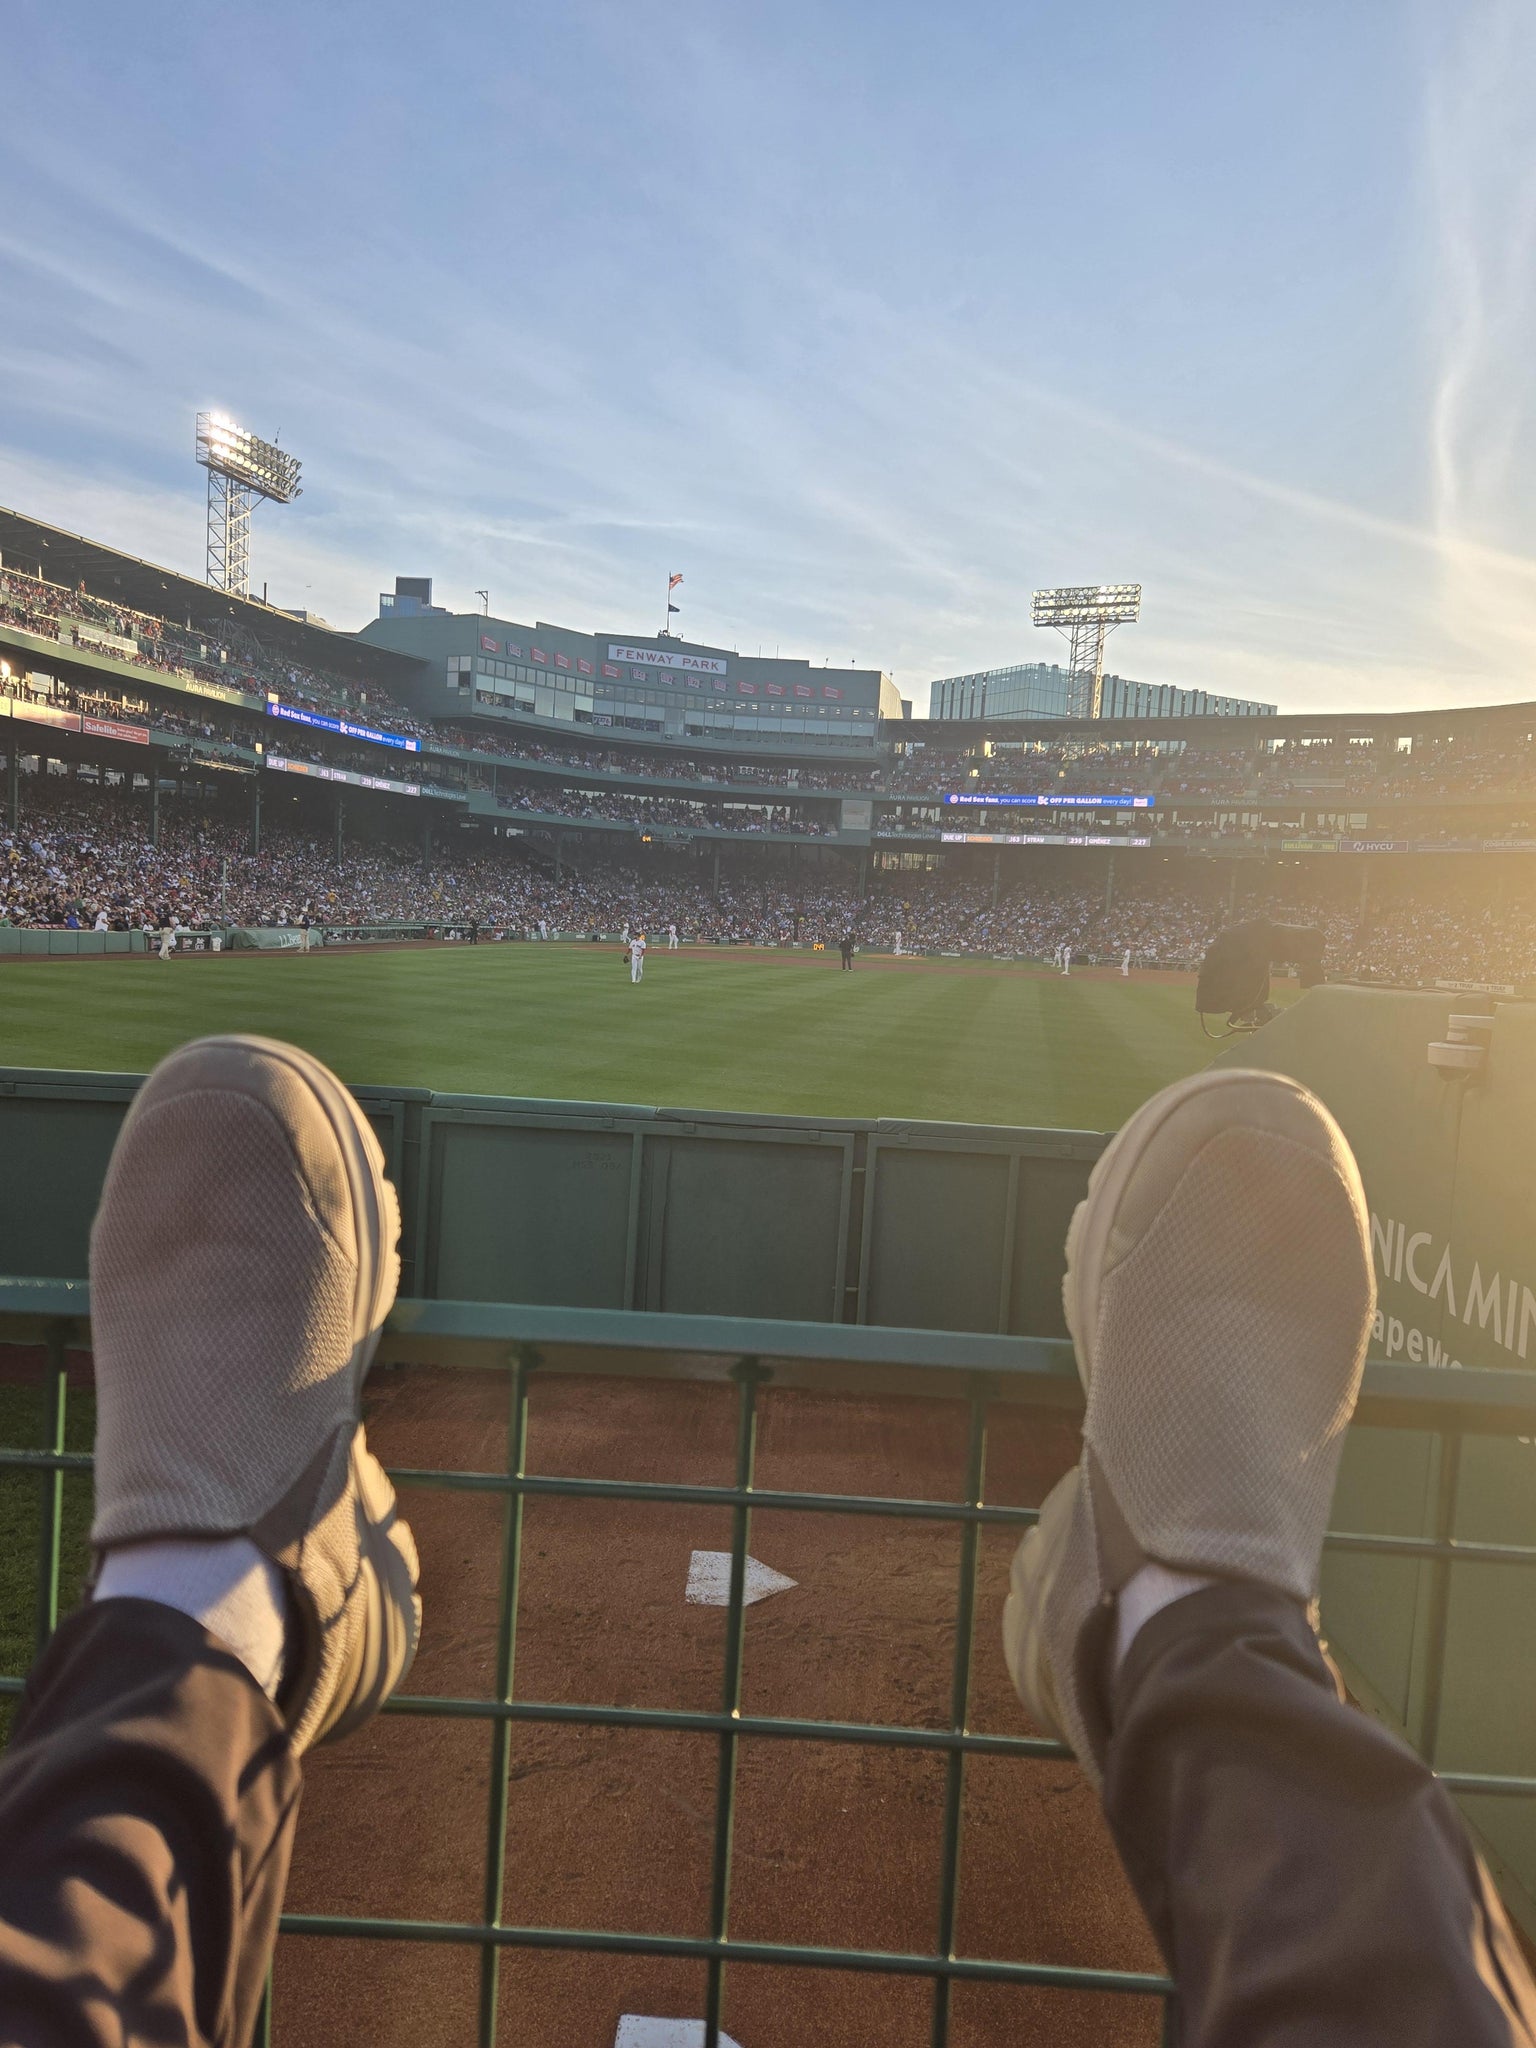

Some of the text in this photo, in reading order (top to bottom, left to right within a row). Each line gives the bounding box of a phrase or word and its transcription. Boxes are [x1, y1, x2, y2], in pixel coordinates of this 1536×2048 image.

[616, 648, 719, 672] FENWAY PARK
[85, 721, 117, 735] Safelite
[280, 707, 291, 717] Red
[291, 710, 300, 720] Sox
[329, 722, 340, 730] score
[348, 726, 357, 735] OFF
[357, 728, 366, 737] PER
[366, 730, 383, 741] GALLON
[383, 737, 394, 745] every
[268, 758, 285, 768] DUE UP
[1076, 797, 1102, 805] GALLON
[1119, 797, 1132, 806] day!
[1132, 838, 1147, 846] .227
[1366, 842, 1394, 850] HYCU
[1370, 1308, 1464, 1369] apew
